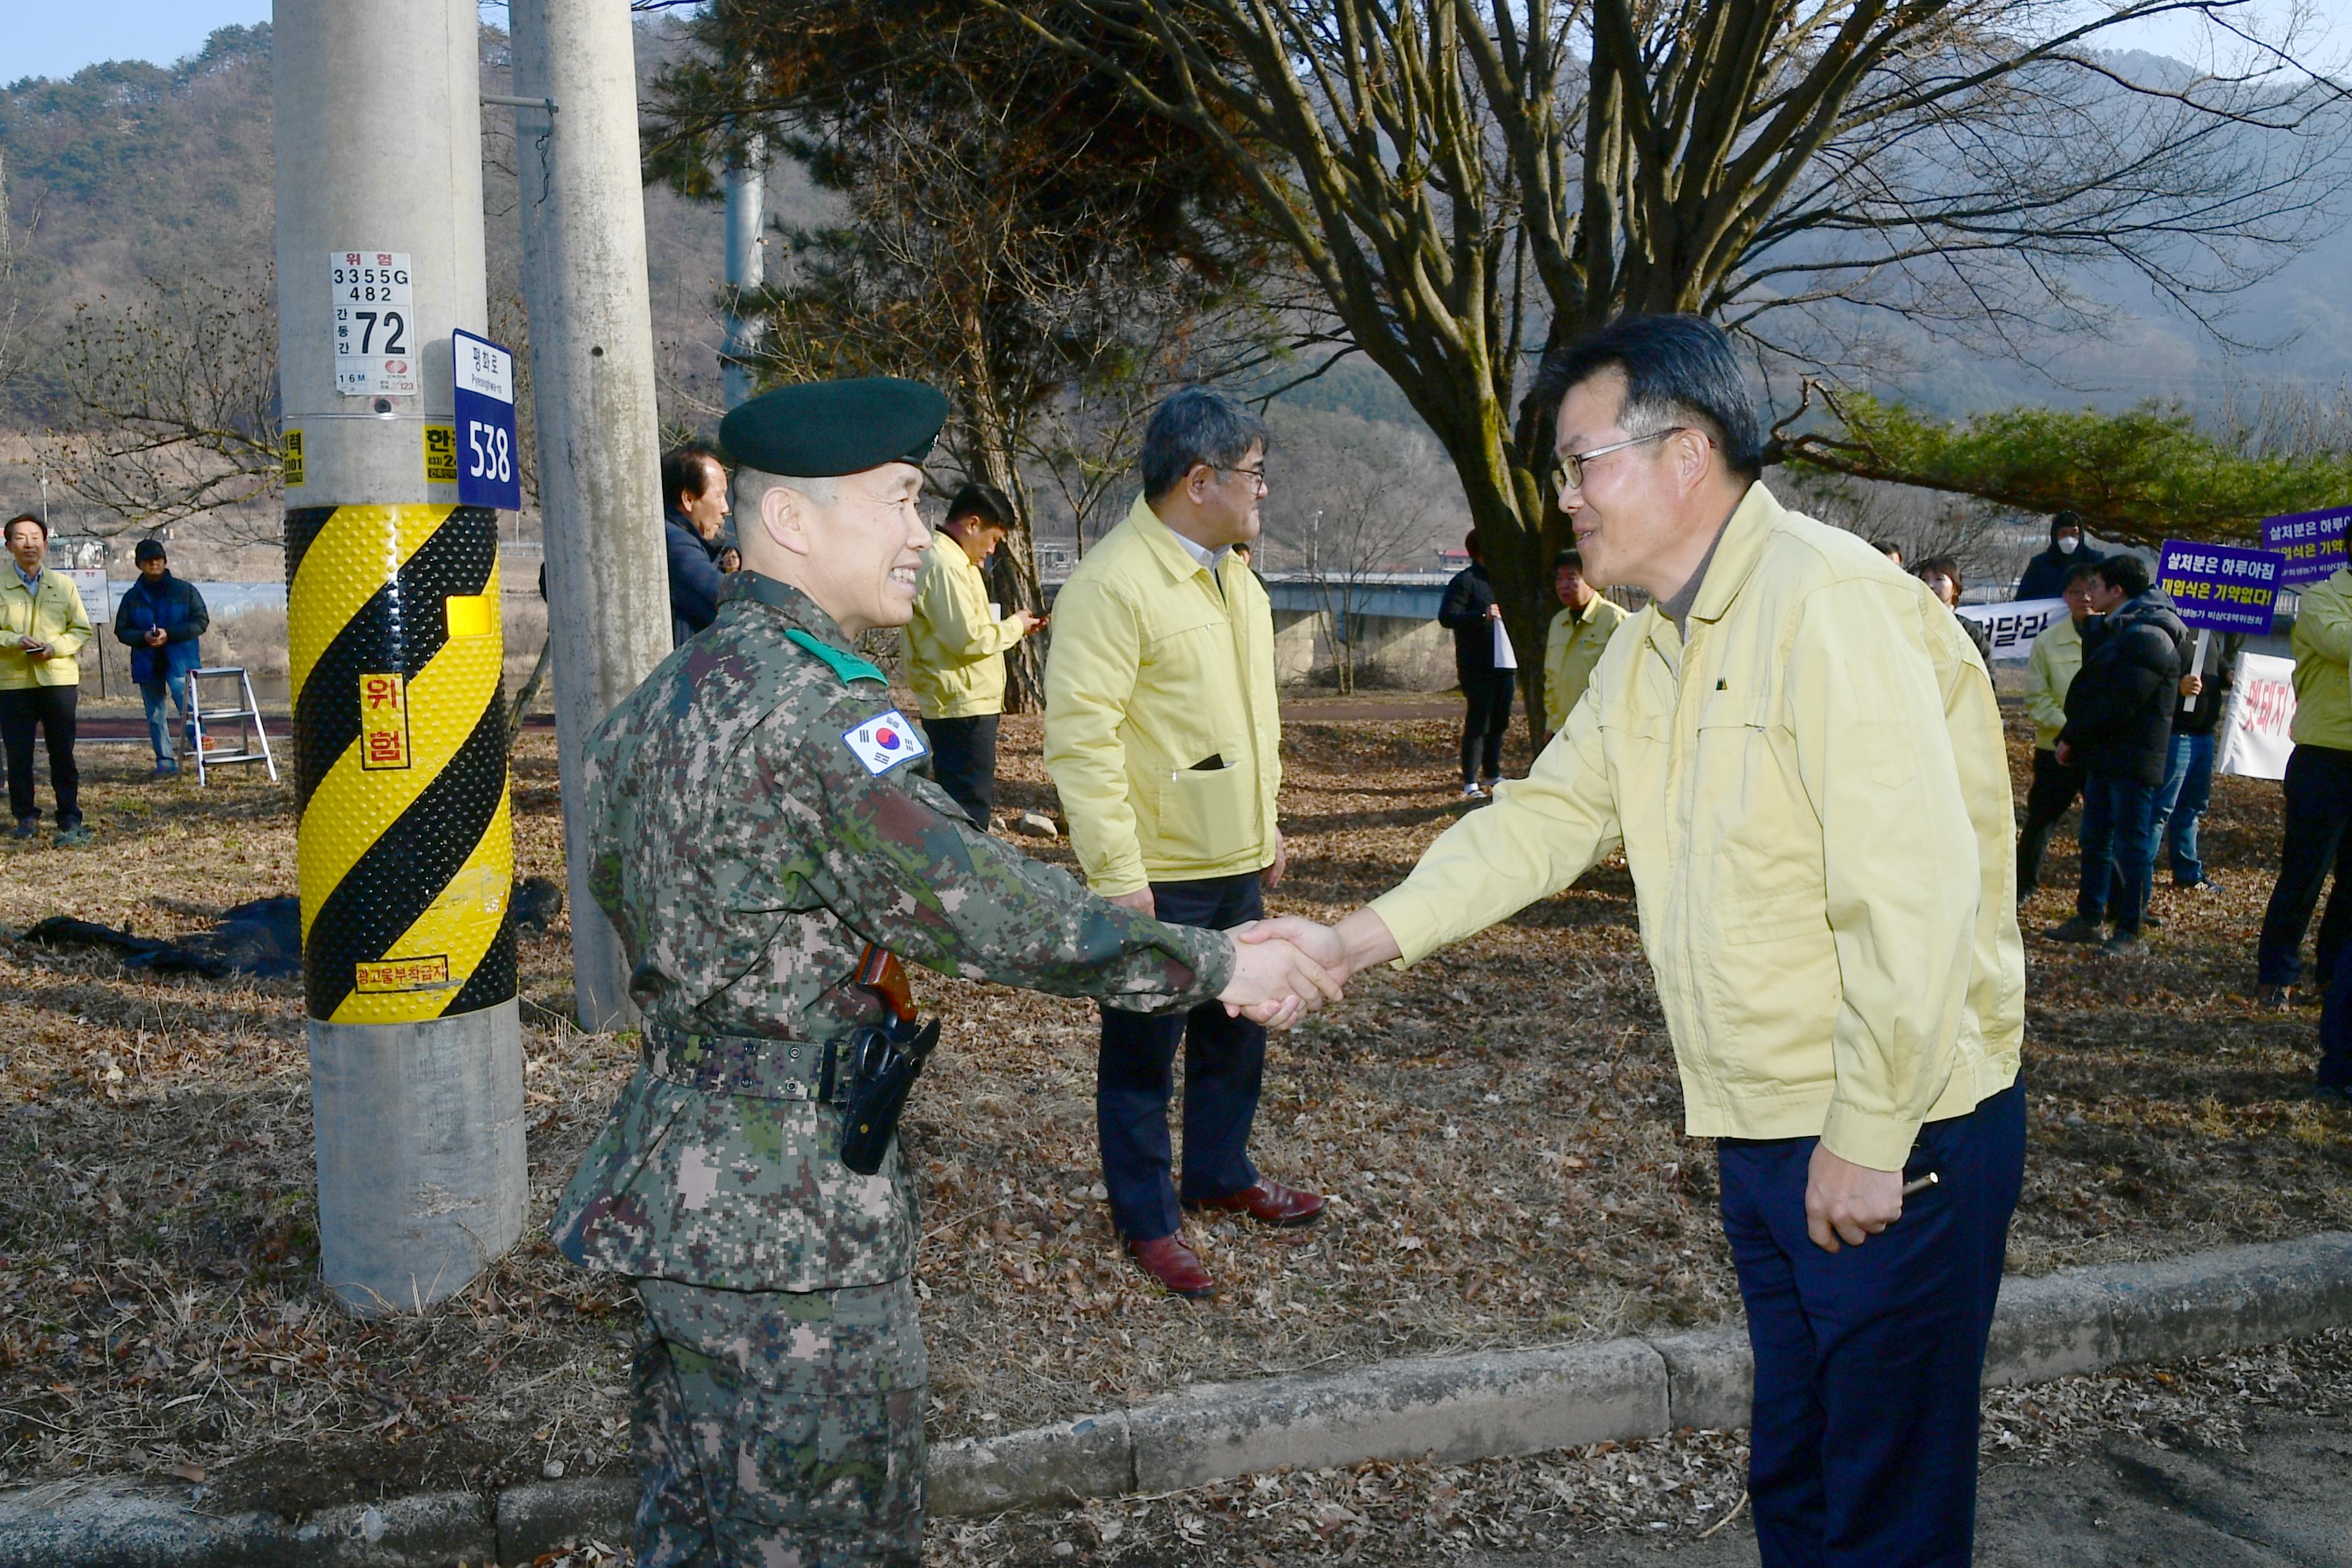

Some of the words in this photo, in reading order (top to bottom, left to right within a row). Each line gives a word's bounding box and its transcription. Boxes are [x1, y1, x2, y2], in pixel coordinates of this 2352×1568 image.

[334, 269, 408, 284] 3355G
[349, 286, 391, 301] 482
[355, 311, 406, 354] 72
[473, 347, 498, 374] 평화로
[427, 429, 455, 453] 한
[469, 420, 511, 483] 538
[2269, 521, 2317, 542] 살처분은
[2168, 552, 2219, 574] 살처분은
[2221, 558, 2275, 581] 하루아침
[367, 679, 400, 761] 위험
